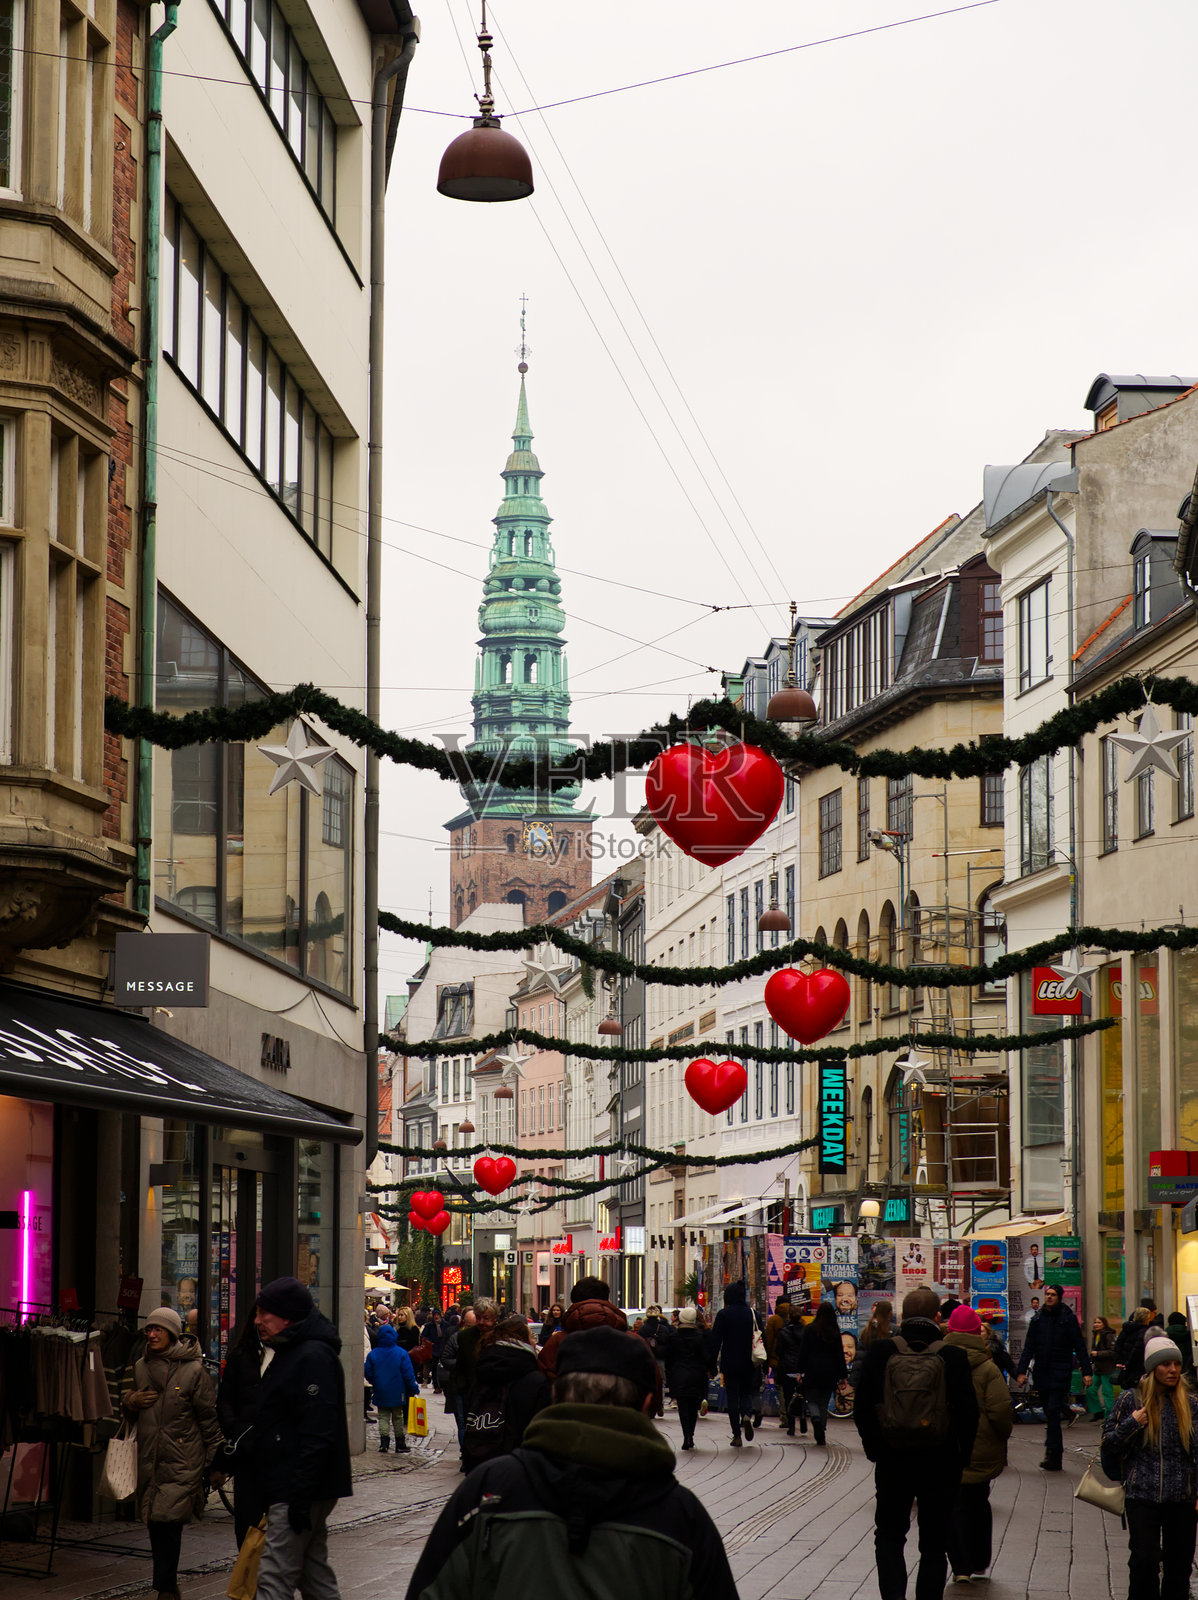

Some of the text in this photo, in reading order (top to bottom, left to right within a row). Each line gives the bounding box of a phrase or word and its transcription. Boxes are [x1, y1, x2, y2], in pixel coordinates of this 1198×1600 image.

[125, 981, 195, 992] MESSAGE
[261, 1032, 292, 1069] ZARA
[822, 1068, 845, 1166] WEEKDAY
